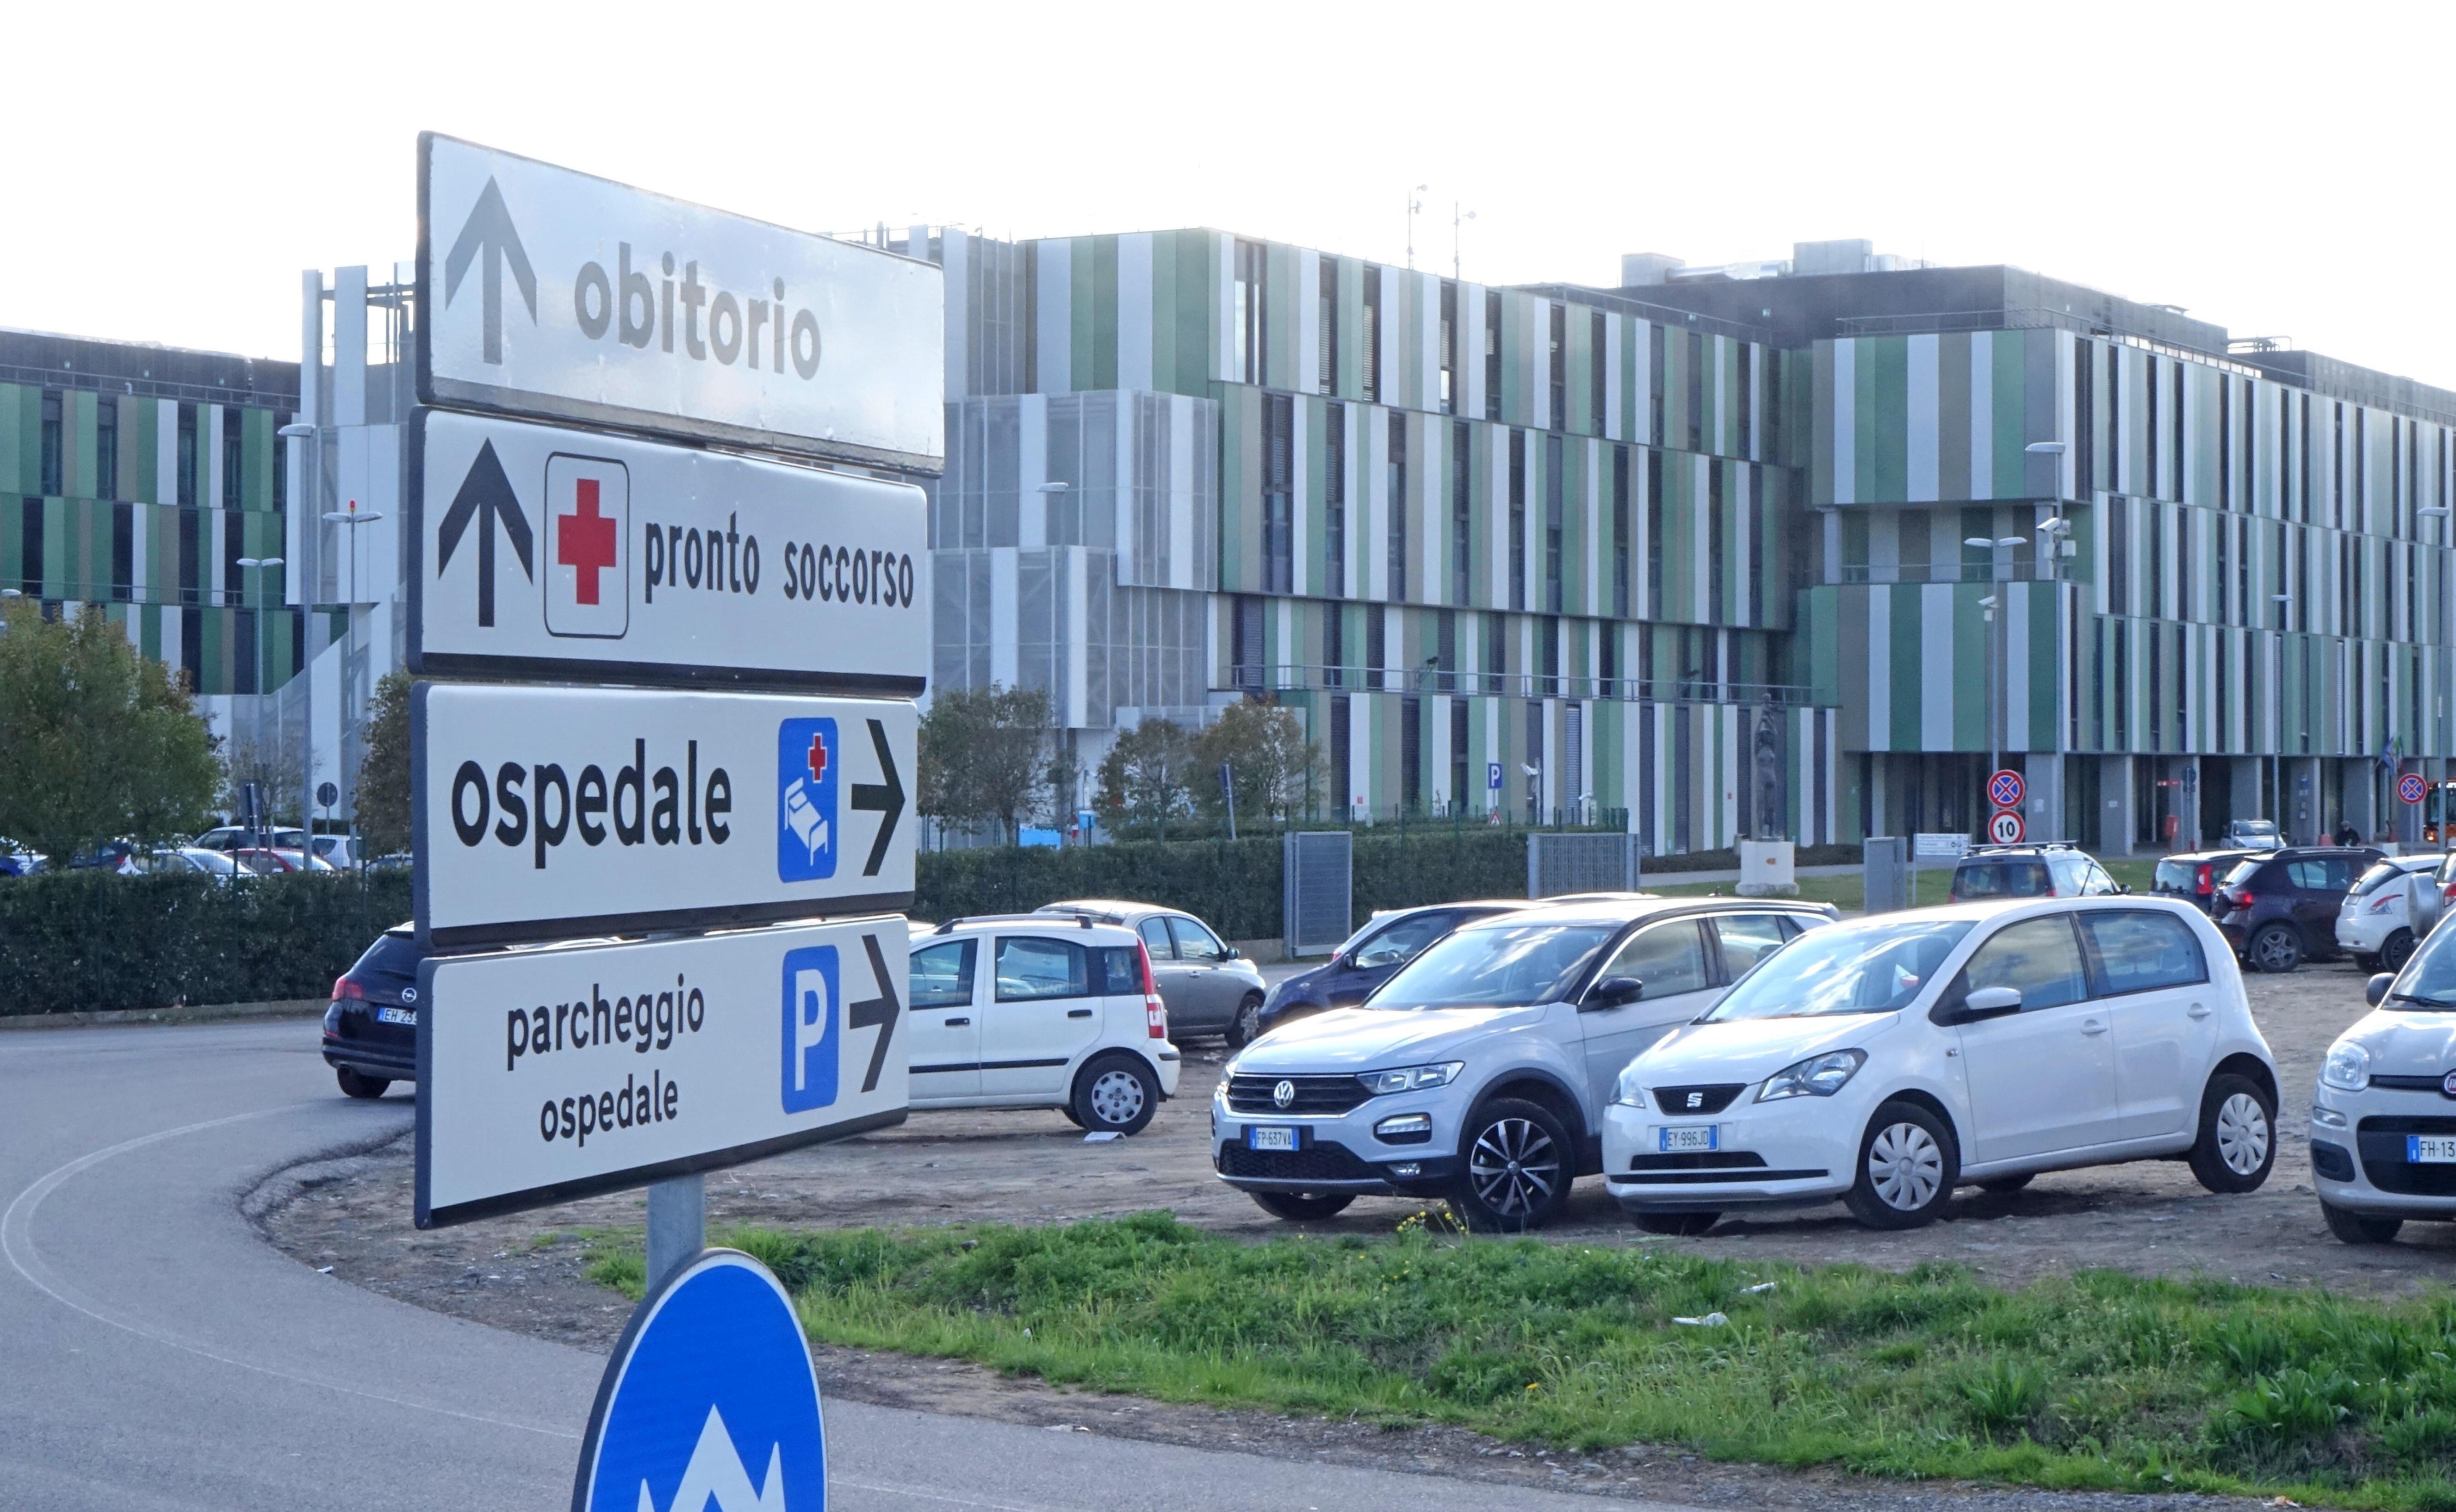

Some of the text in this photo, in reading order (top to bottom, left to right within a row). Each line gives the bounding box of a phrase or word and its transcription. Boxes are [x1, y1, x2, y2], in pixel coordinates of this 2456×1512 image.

[575, 242, 821, 379] obitorio
[645, 512, 913, 608] pronto soccorso
[452, 739, 732, 869] ospedale
[1491, 765, 1500, 787] P
[1998, 821, 2015, 837] 10
[507, 974, 704, 1071] parcheggio
[795, 969, 827, 1091] P
[541, 1070, 678, 1147] ospedale
